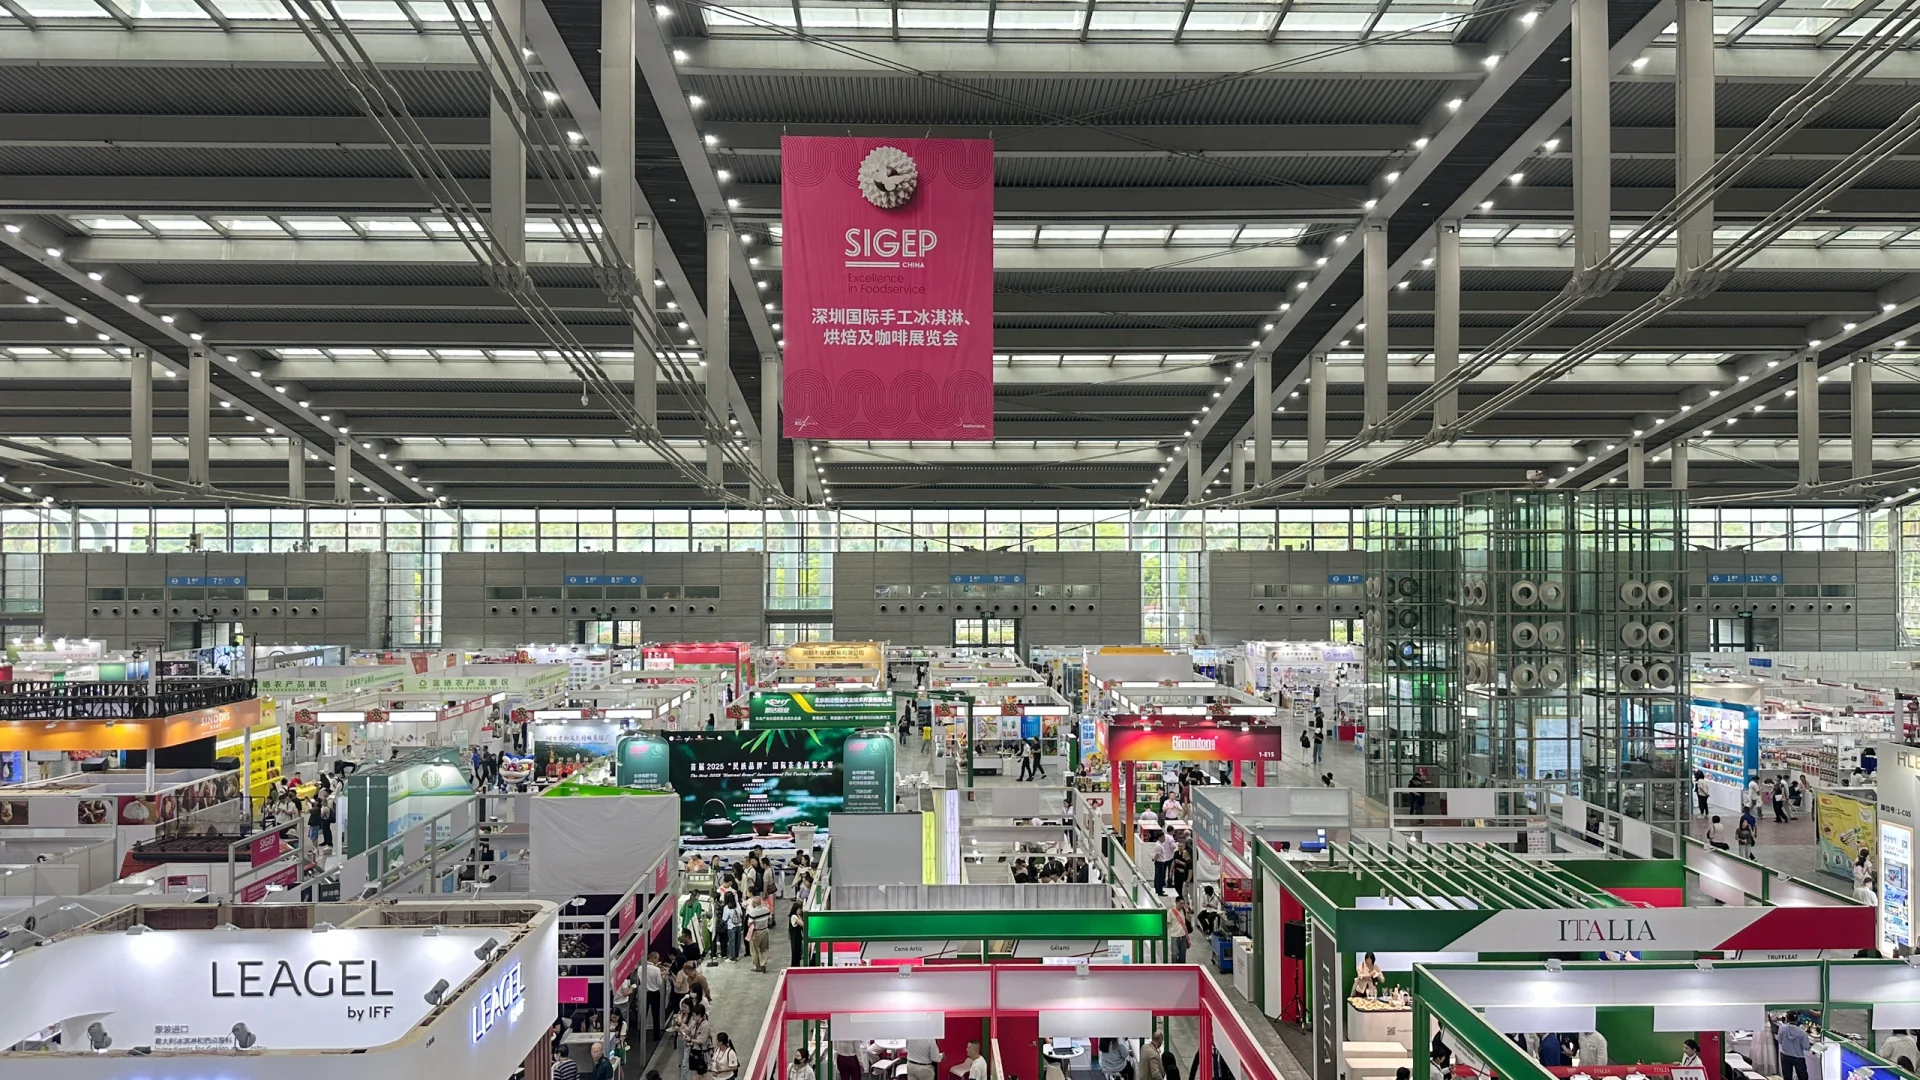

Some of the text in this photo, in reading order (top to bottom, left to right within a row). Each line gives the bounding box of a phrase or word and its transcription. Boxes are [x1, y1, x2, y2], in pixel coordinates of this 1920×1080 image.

[844, 228, 937, 258] SIGEP
[848, 272, 904, 283] Excellence
[848, 284, 926, 294] in Foodservice
[812, 308, 971, 326] 深圳国际手工冰淇淋、
[824, 330, 958, 346] 烘焙及咖啡展览会
[201, 712, 230, 726] SINODIS
[1172, 736, 1212, 751] Birminton
[260, 835, 276, 848] SIGEP
[1558, 919, 1656, 942] ITALIA
[212, 960, 393, 997] LEAGEL
[472, 962, 525, 1043] LEAGEL
[348, 1006, 393, 1020] by IFF
[1322, 960, 1332, 1064] ITALIA
